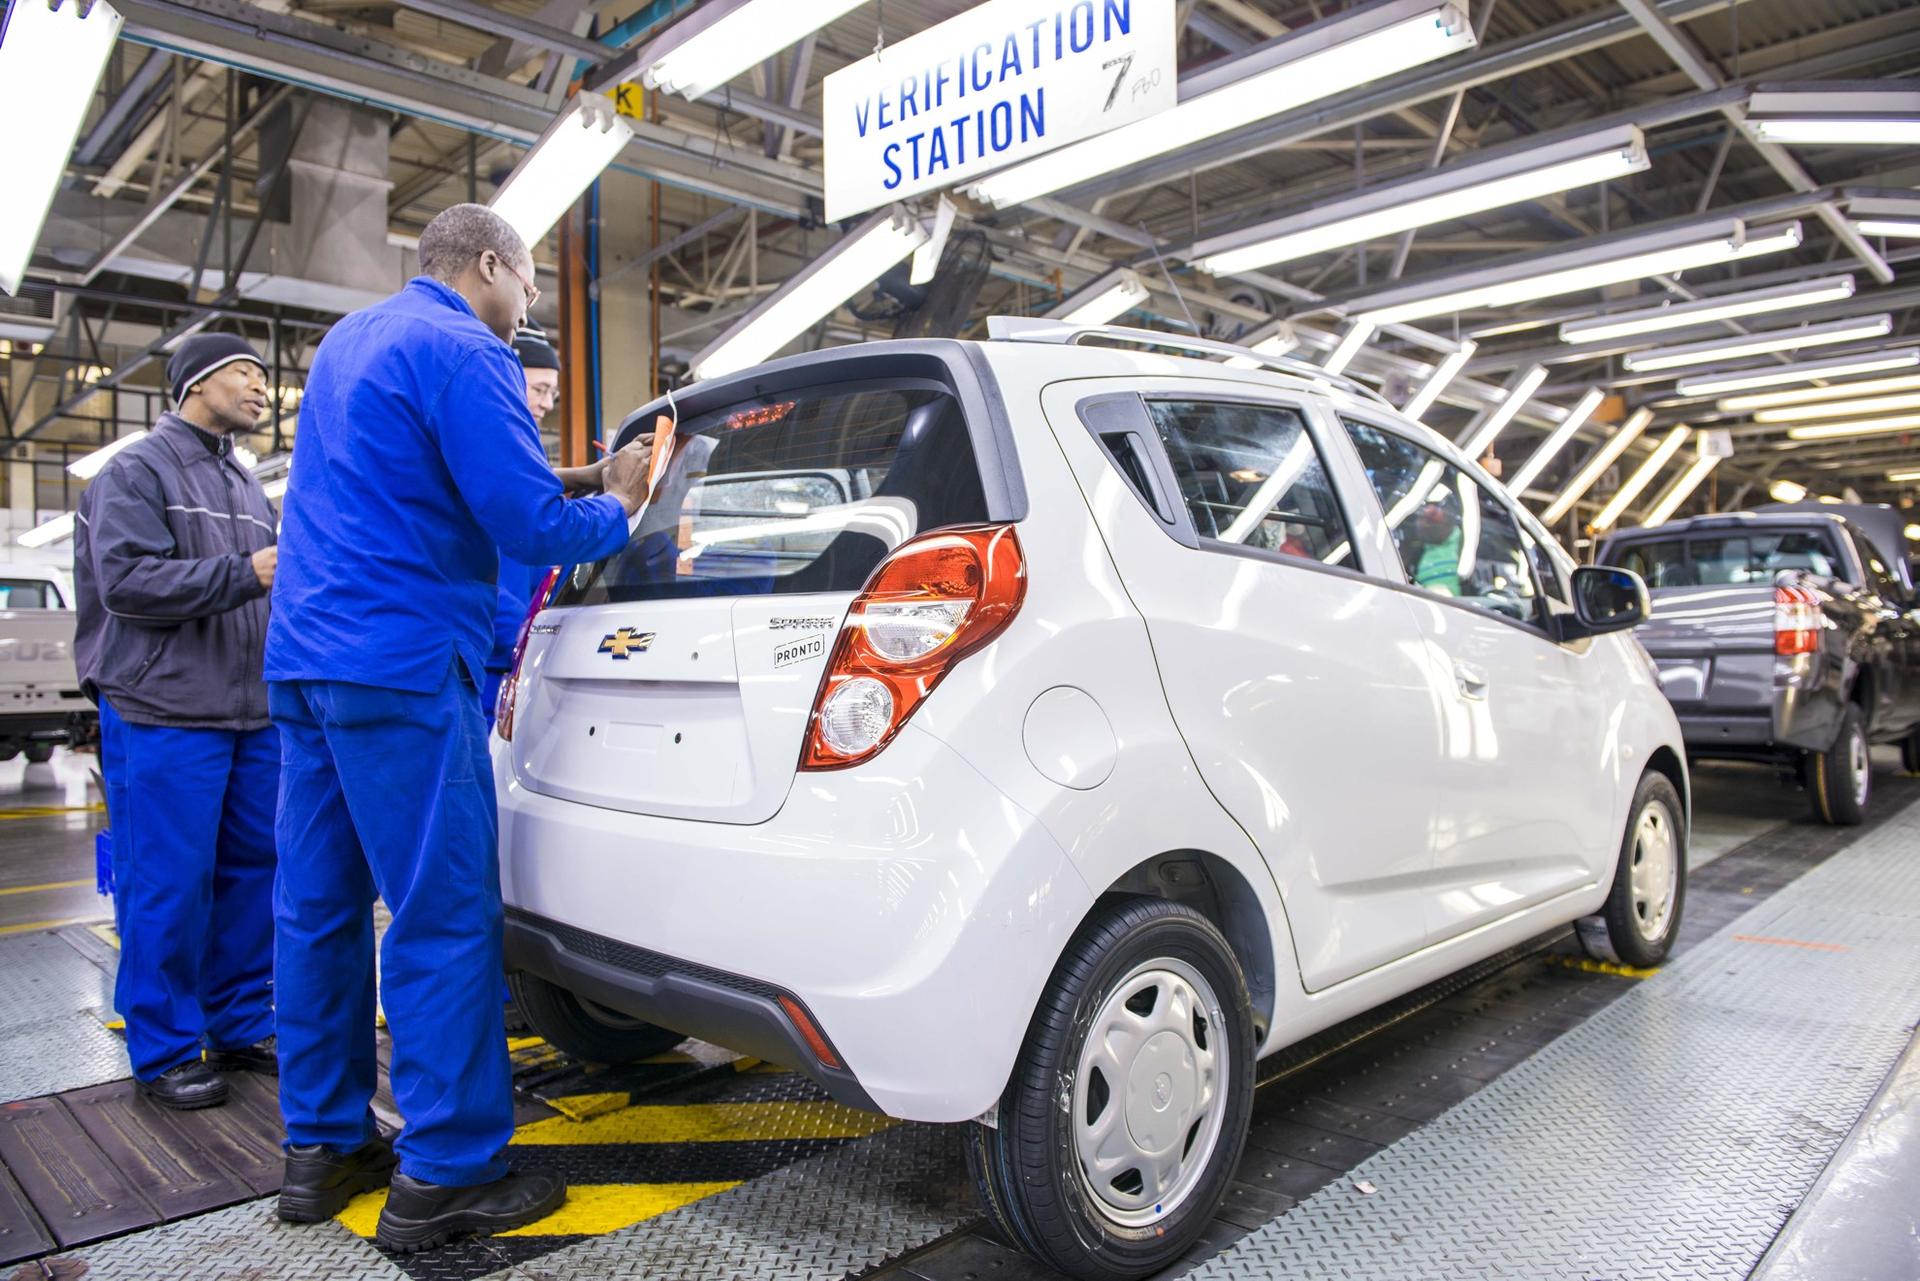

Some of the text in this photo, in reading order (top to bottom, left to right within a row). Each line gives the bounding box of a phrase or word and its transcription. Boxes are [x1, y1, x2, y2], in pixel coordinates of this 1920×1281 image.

[855, 0, 1130, 138] VERIFICATION
[1102, 50, 1136, 112] 7
[882, 87, 1045, 190] STATION
[776, 640, 821, 663] PRONTO
